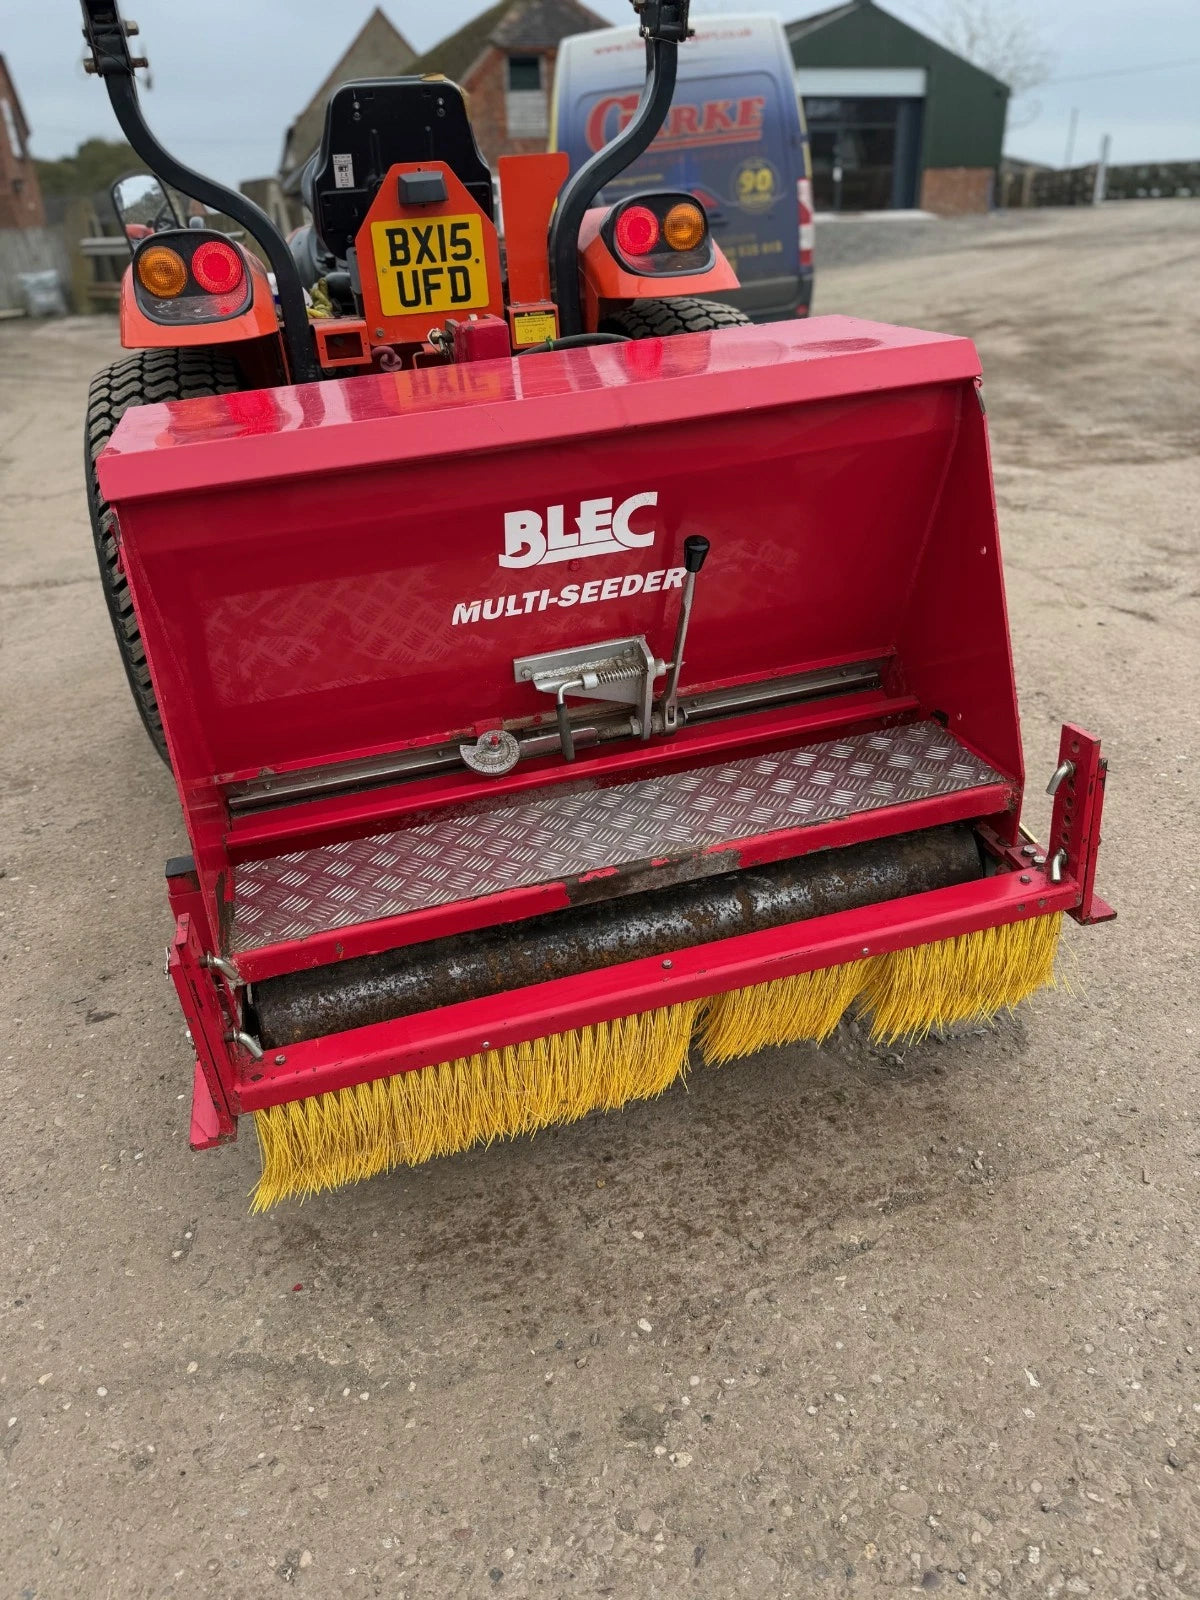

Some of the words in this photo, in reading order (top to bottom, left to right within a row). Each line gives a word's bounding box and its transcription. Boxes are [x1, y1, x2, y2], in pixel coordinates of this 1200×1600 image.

[738, 167, 774, 193] 90
[385, 222, 473, 267] BX15
[396, 265, 472, 308] UFD
[499, 491, 658, 569] BLEC
[451, 567, 687, 626] MULTI-SEEDER
